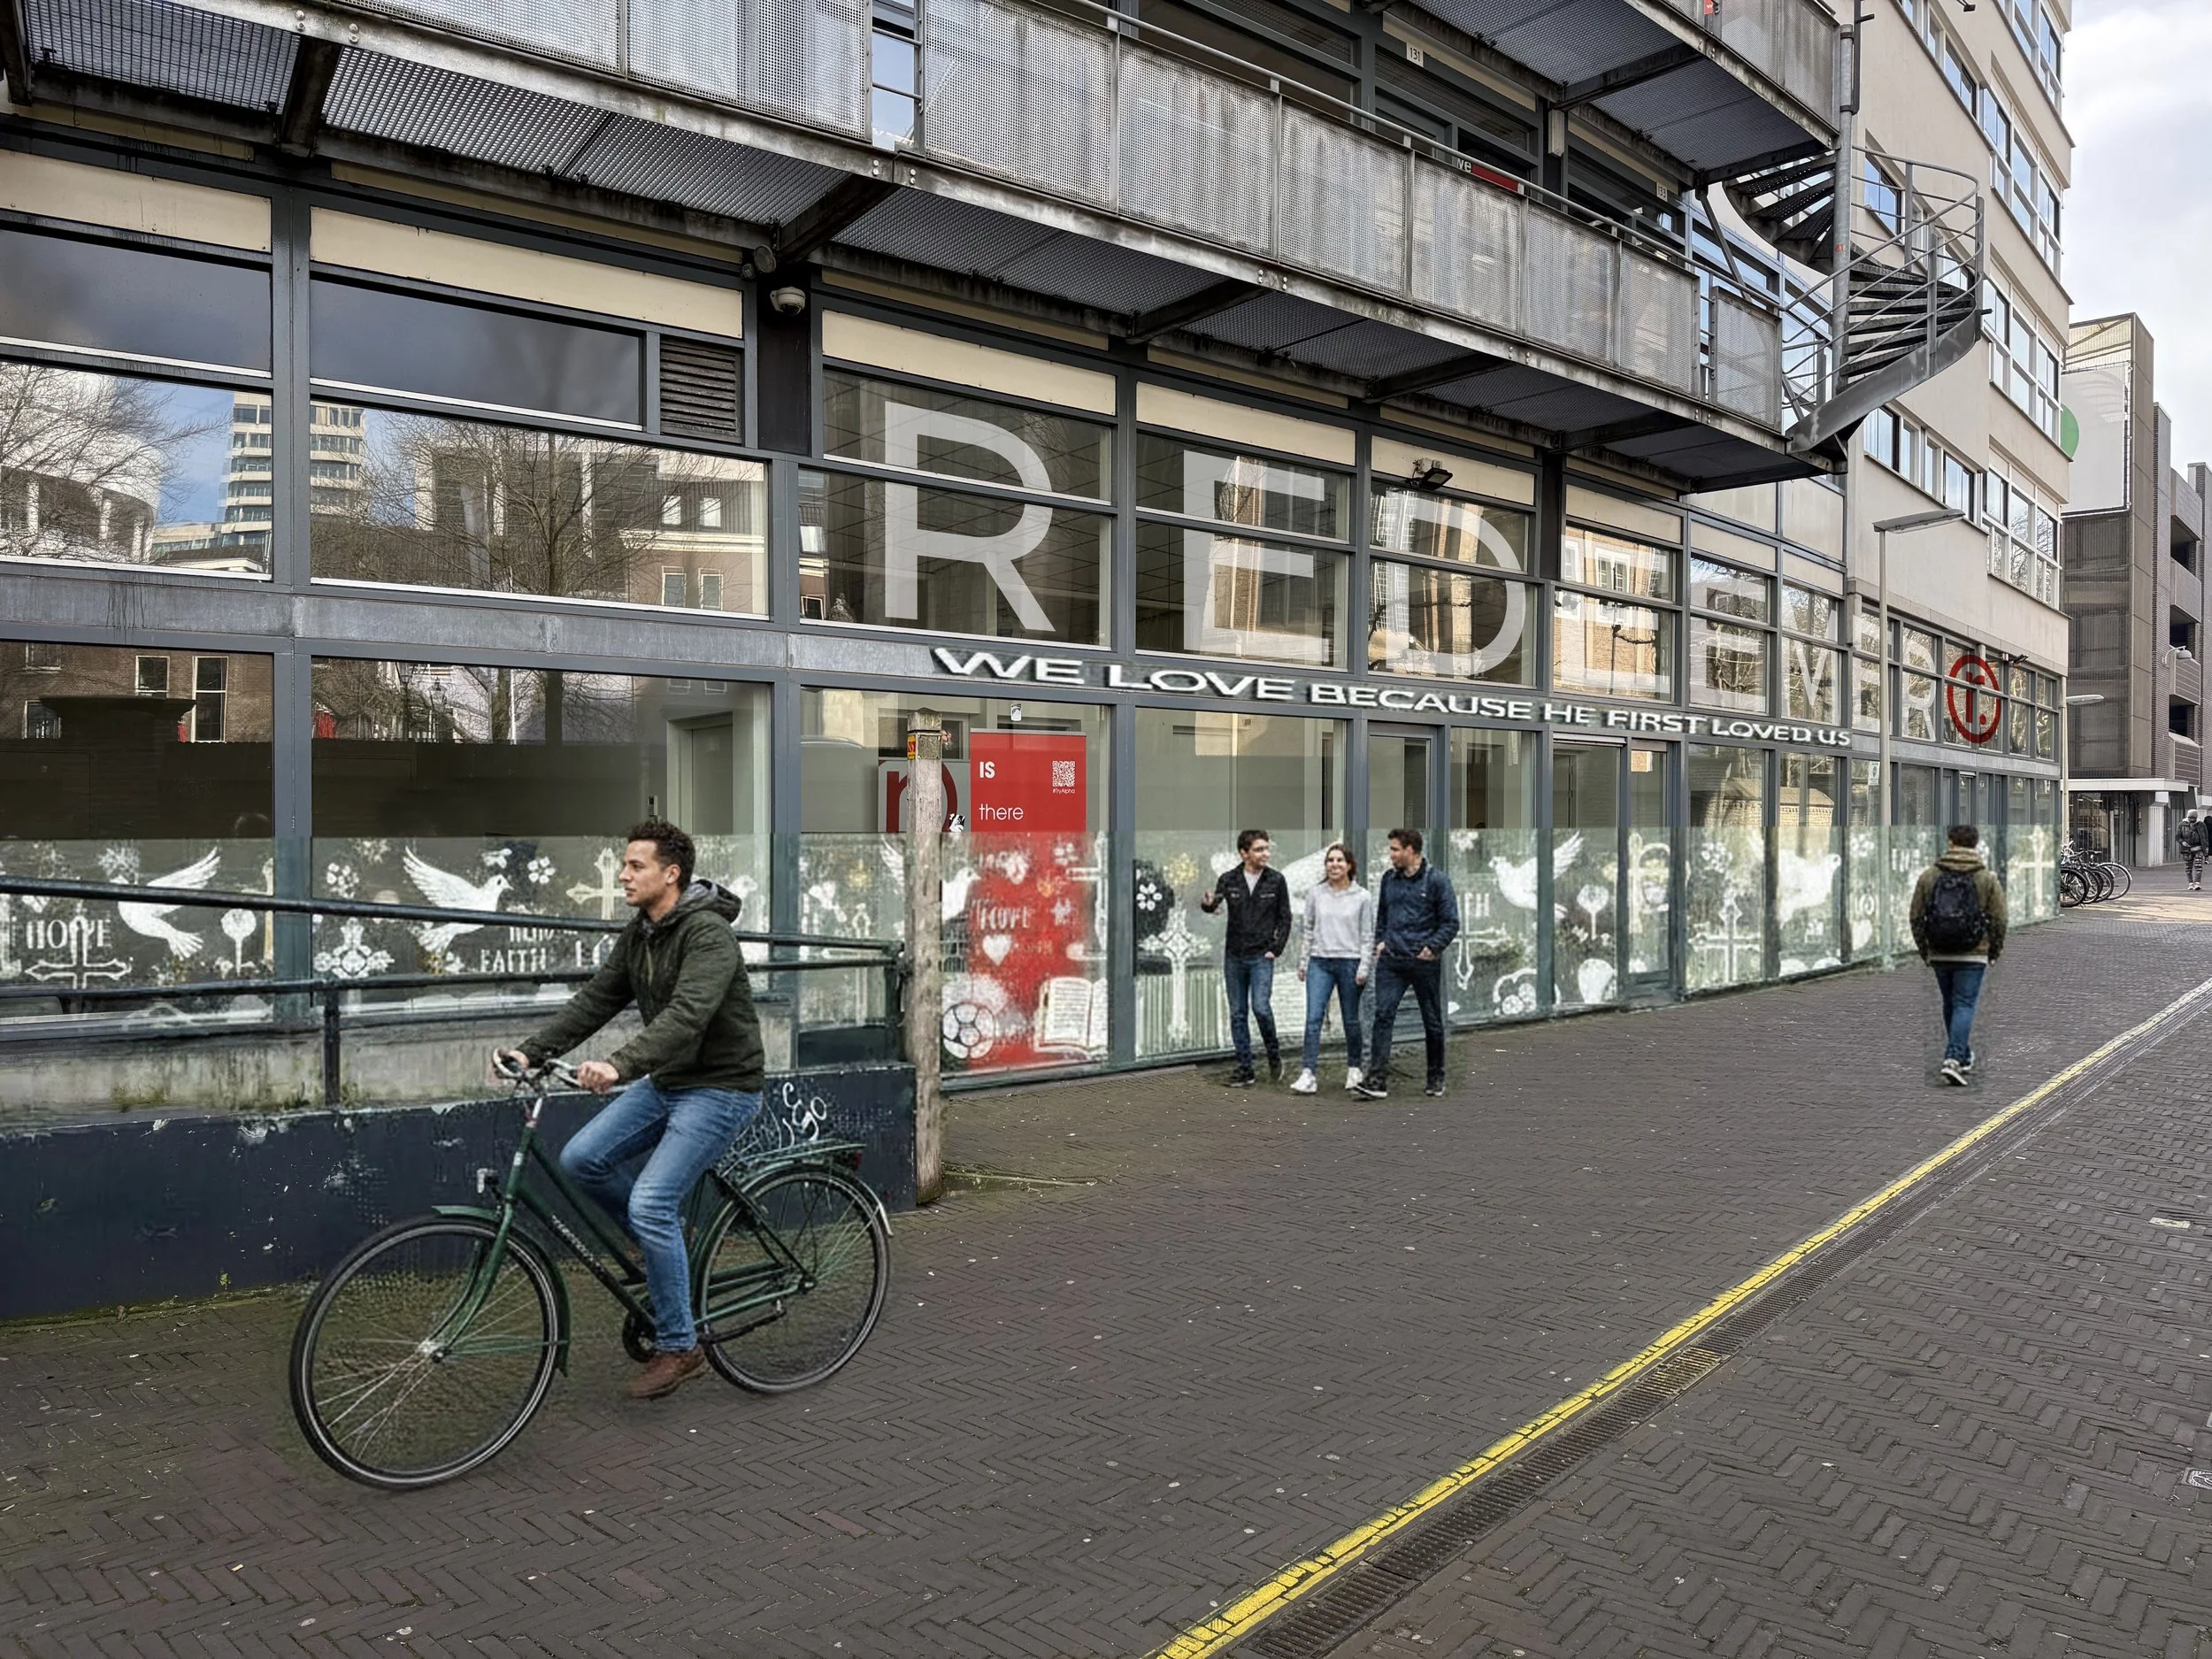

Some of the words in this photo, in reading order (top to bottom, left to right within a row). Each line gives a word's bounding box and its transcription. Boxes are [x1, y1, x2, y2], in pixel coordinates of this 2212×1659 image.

[1409, 47, 1421, 62] 131
[934, 647, 1085, 685] WE
[1109, 664, 1295, 701] LOVE
[1311, 684, 1533, 719] BECAUSE
[1544, 703, 1595, 724] HE
[1607, 710, 1707, 733] FIRST
[1711, 718, 1811, 742] LOVED
[979, 761, 995, 779] IS
[979, 803, 1024, 820] there
